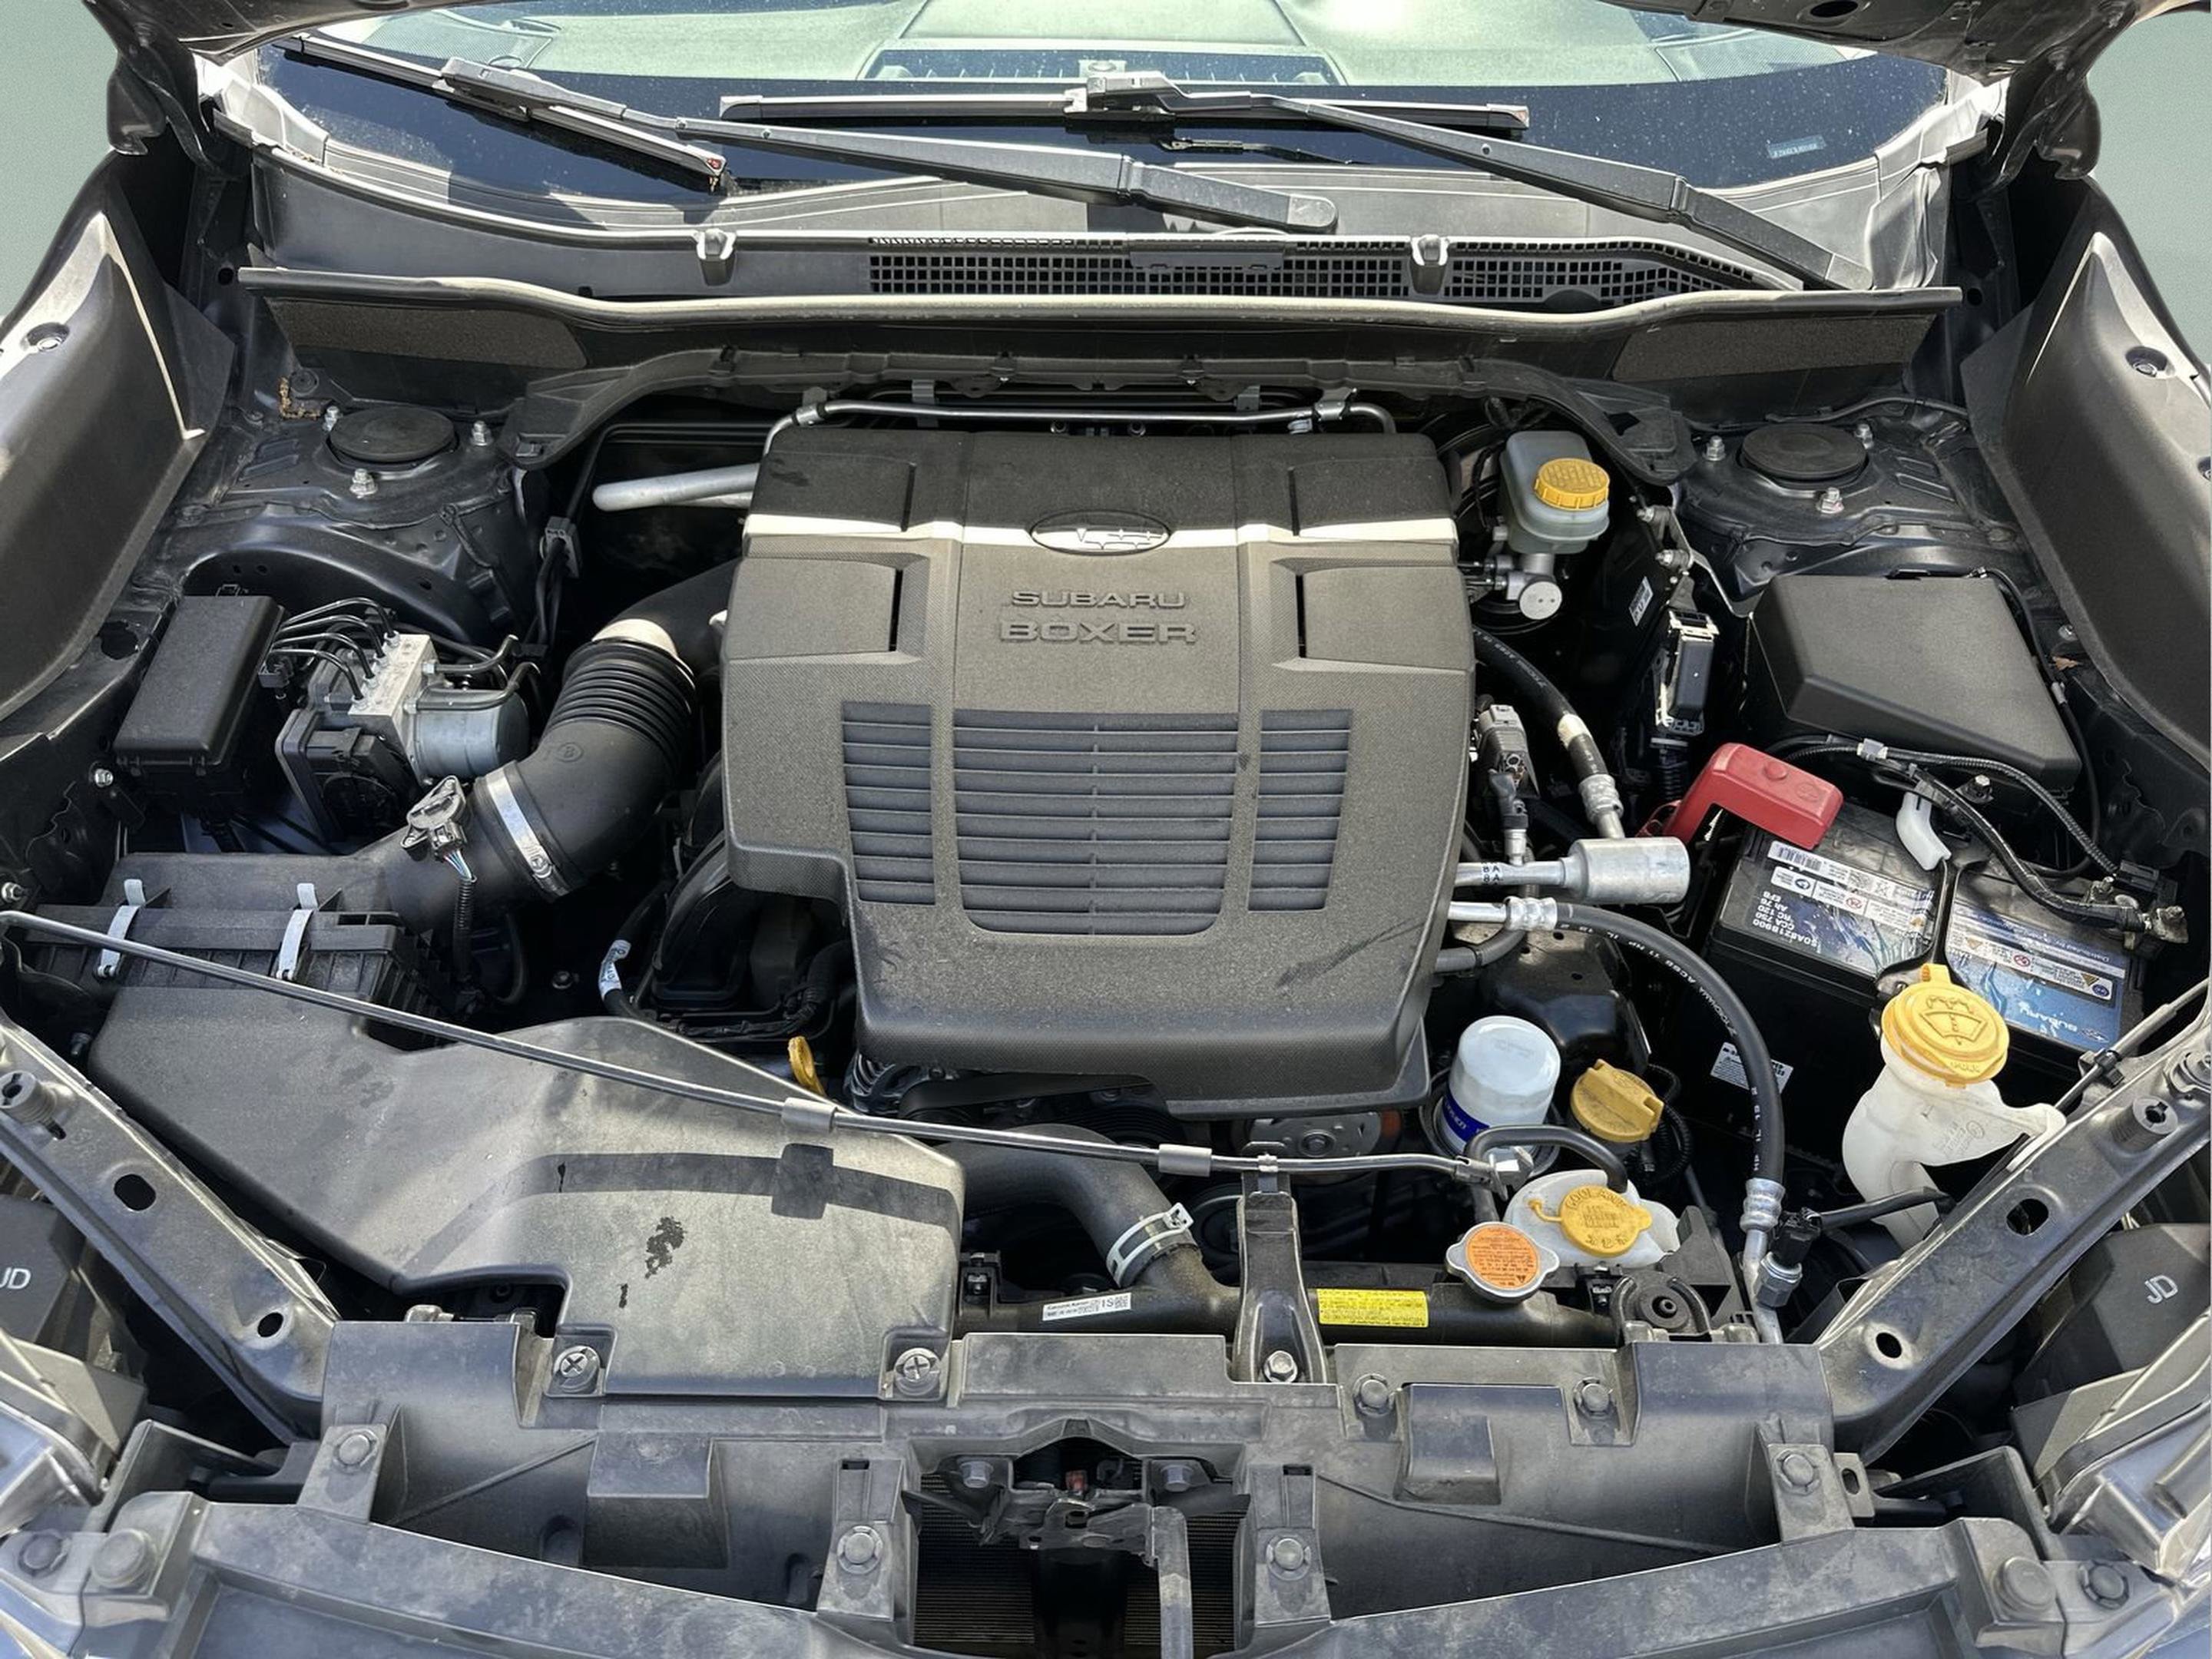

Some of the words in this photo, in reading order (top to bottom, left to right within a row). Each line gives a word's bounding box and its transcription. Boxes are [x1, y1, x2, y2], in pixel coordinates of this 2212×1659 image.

[1012, 591, 1186, 609] SUBARU
[999, 621, 1197, 644] BOXER
[1763, 891, 1781, 902] EFB
[1757, 905, 1774, 916] 120
[1774, 902, 1788, 912] Ah
[1755, 912, 1773, 923] 750
[1777, 912, 1791, 921] RC
[1775, 918, 1795, 931] CCA
[2020, 1007, 2078, 1032] SUBARU
[2144, 1275, 2178, 1303] JD
